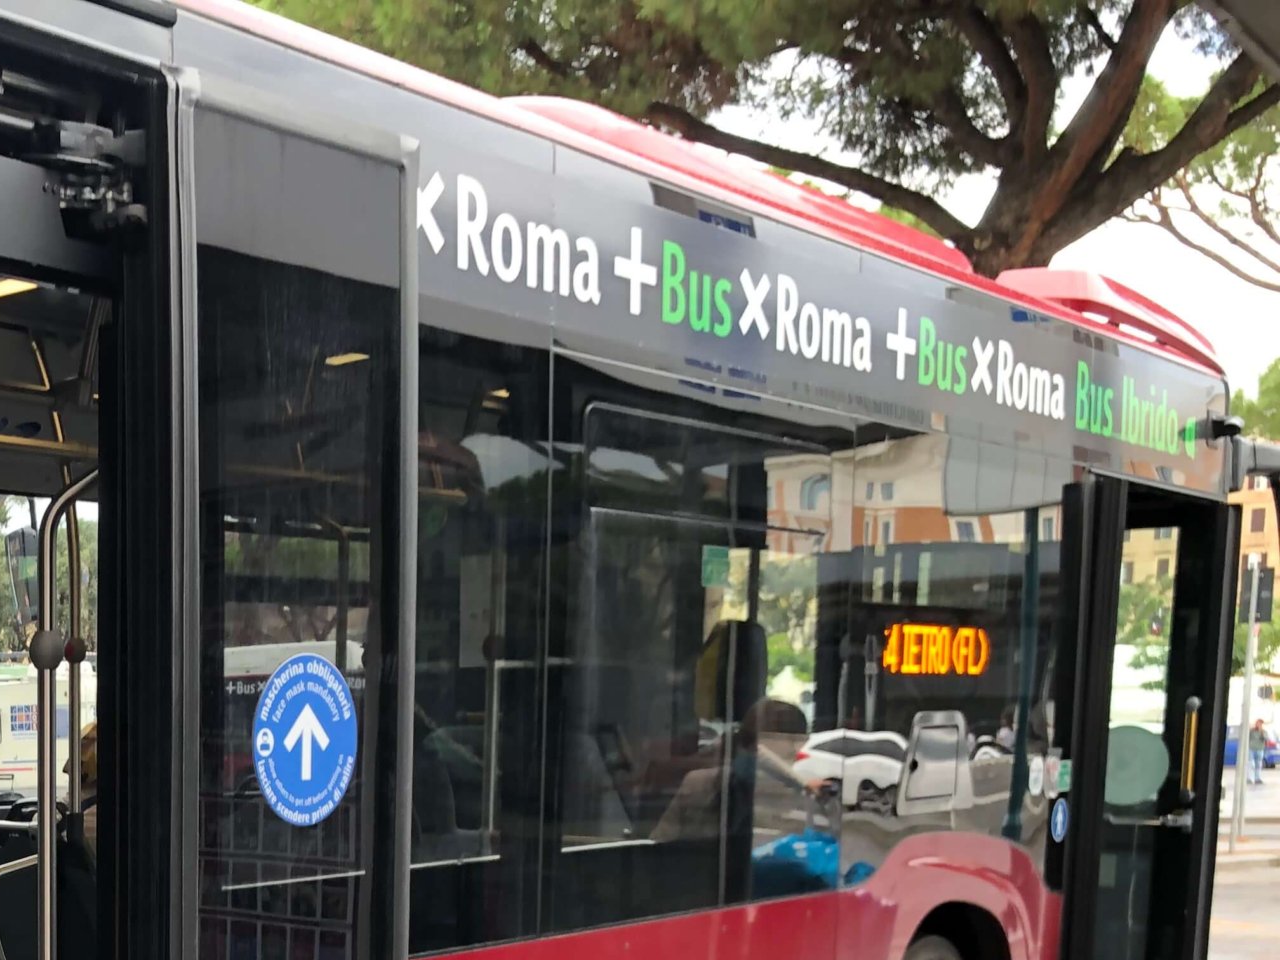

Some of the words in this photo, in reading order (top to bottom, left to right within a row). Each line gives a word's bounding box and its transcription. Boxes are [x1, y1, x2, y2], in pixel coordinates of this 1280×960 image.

[1076, 360, 1114, 437] Bus
[1121, 375, 1179, 456] Ibrido
[261, 661, 304, 721] mascherina
[307, 660, 350, 721] obbligatoria
[272, 699, 286, 724] face
[286, 680, 306, 702] mask
[307, 682, 340, 722] mandatory
[258, 760, 277, 804] lasciare
[276, 802, 310, 823] scendere
[312, 801, 334, 825] prima
[340, 756, 354, 790] salire
